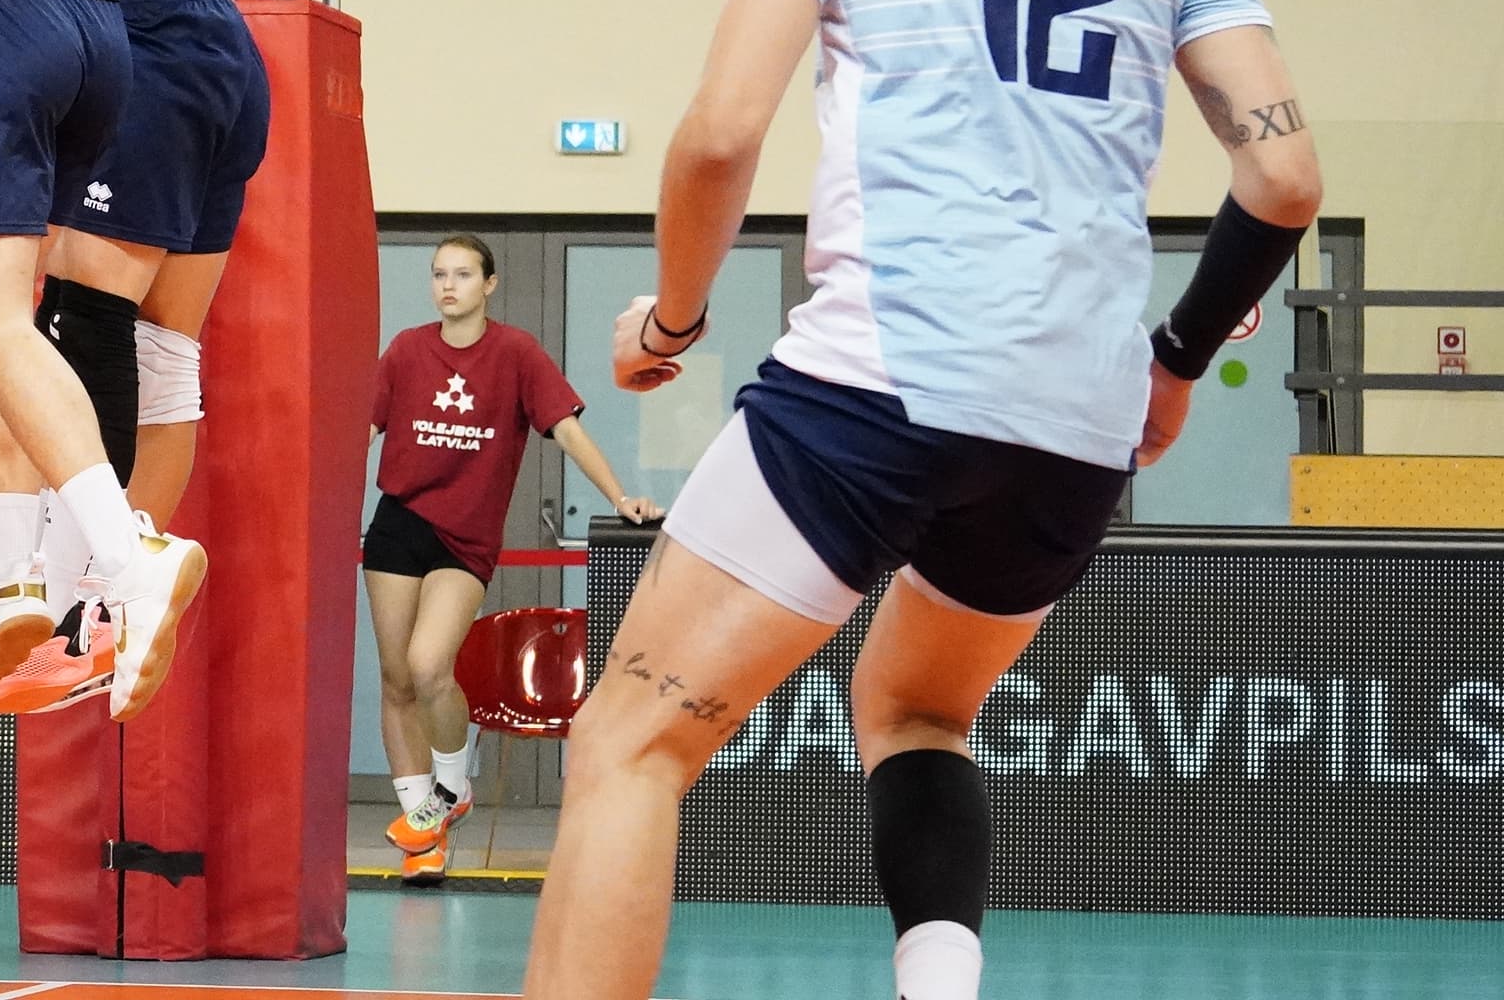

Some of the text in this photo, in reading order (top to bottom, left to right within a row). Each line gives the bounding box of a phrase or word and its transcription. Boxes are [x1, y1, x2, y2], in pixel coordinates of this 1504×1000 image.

[412, 419, 495, 440] VOLEJBOLS
[416, 432, 481, 451] LATVIJA
[705, 671, 1504, 784] AGAVPILS
